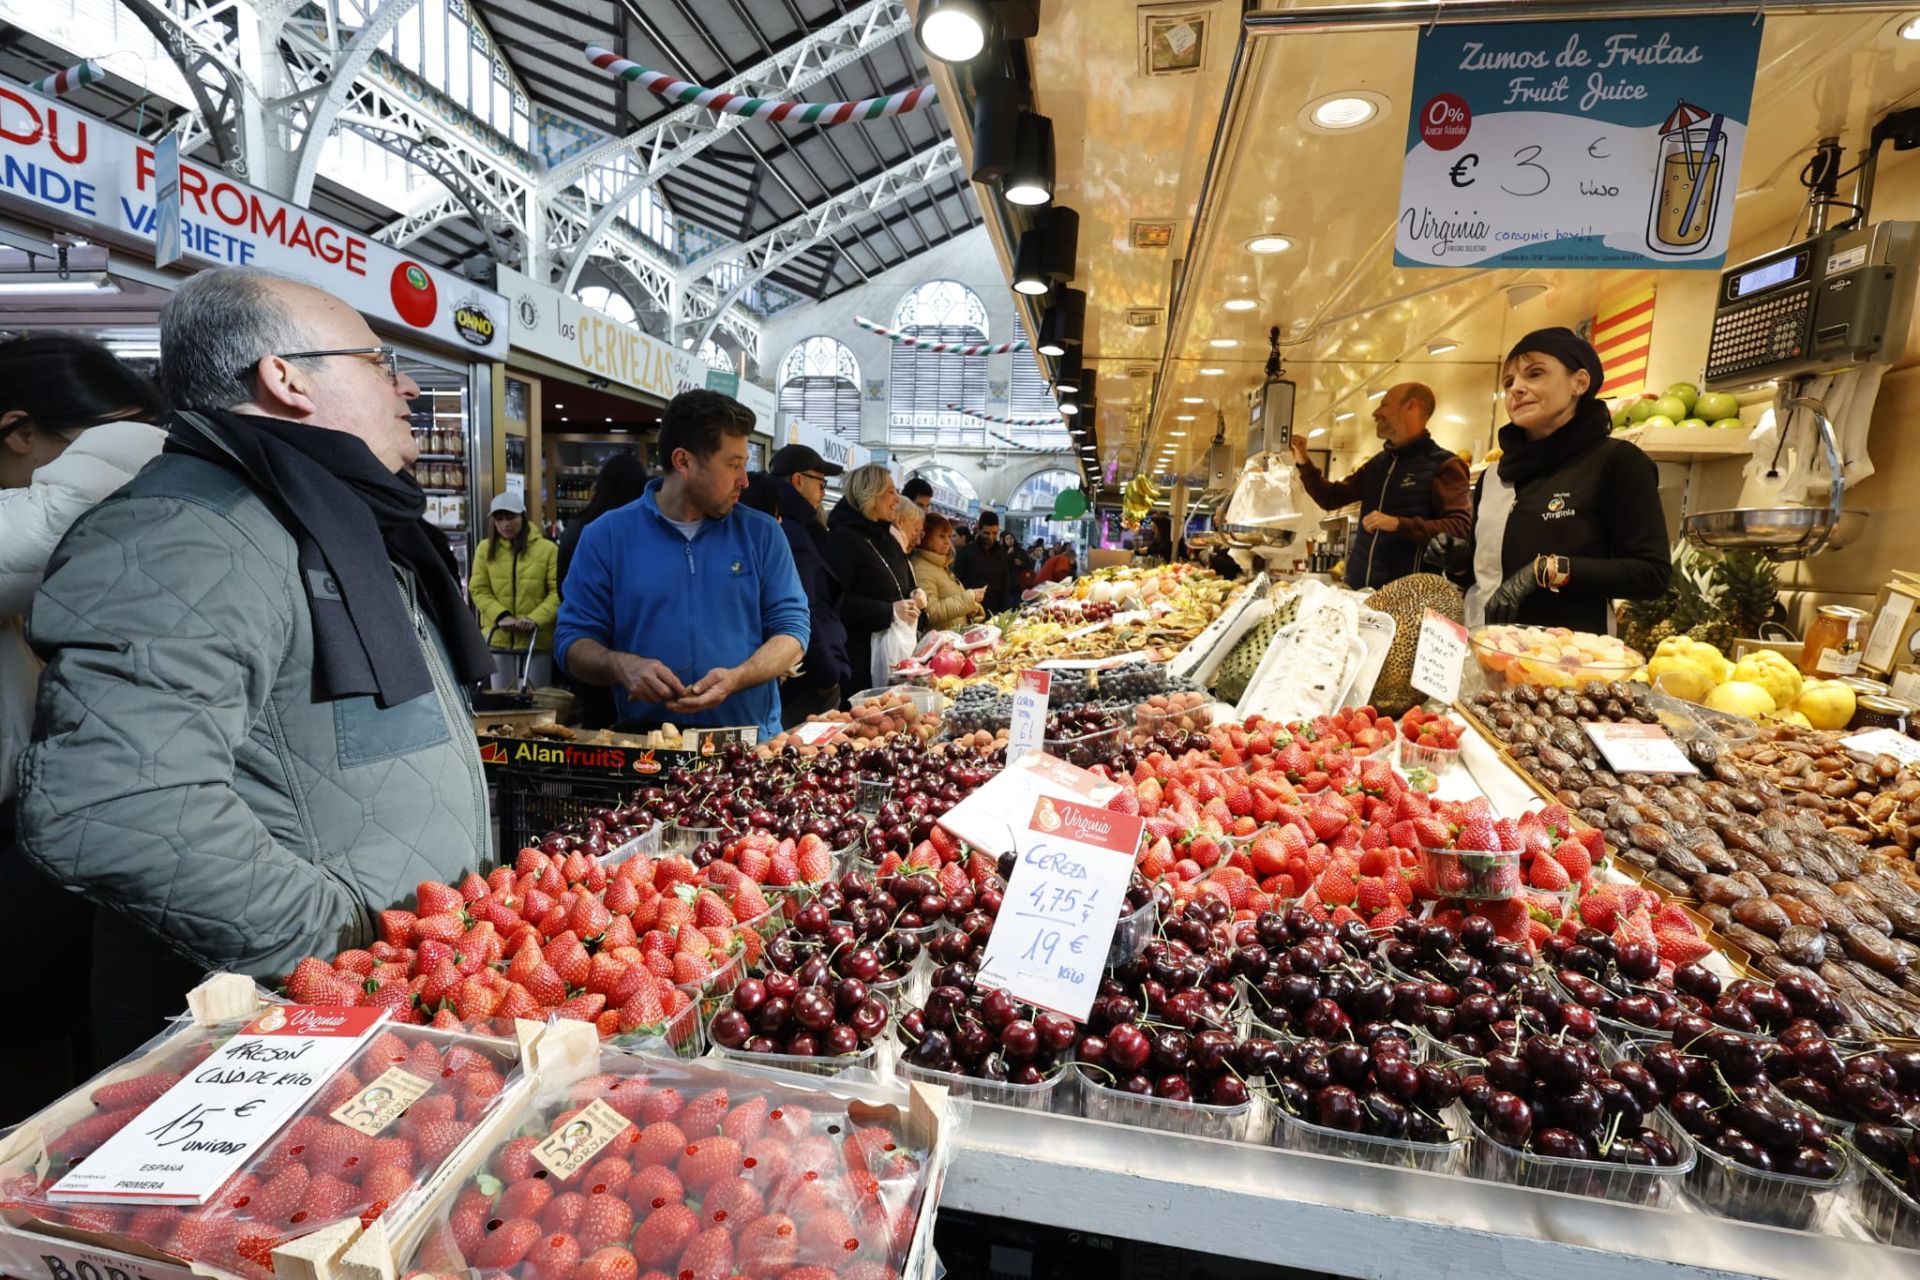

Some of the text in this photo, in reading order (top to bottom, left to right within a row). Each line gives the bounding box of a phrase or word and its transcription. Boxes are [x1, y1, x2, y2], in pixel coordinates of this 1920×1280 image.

[1459, 33, 1703, 70] Zumos de Frutas
[1504, 72, 1648, 111] Fruit Juice
[1429, 100, 1464, 124] 0%
[0, 153, 96, 217] NDE
[1500, 146, 1550, 196] 3
[136, 146, 366, 277] FROMAGE
[1400, 207, 1490, 256] Virginia
[557, 298, 575, 341] las
[578, 316, 673, 397] CERVEZAS
[1541, 508, 1576, 521] Virginia
[1060, 806, 1111, 838] Virginia
[1021, 928, 1089, 965] 19 €
[290, 1009, 347, 1033] Virginia
[145, 1099, 266, 1146] 15 €
[564, 1136, 608, 1171] BORJA
[114, 1180, 165, 1189] PRIMERA
